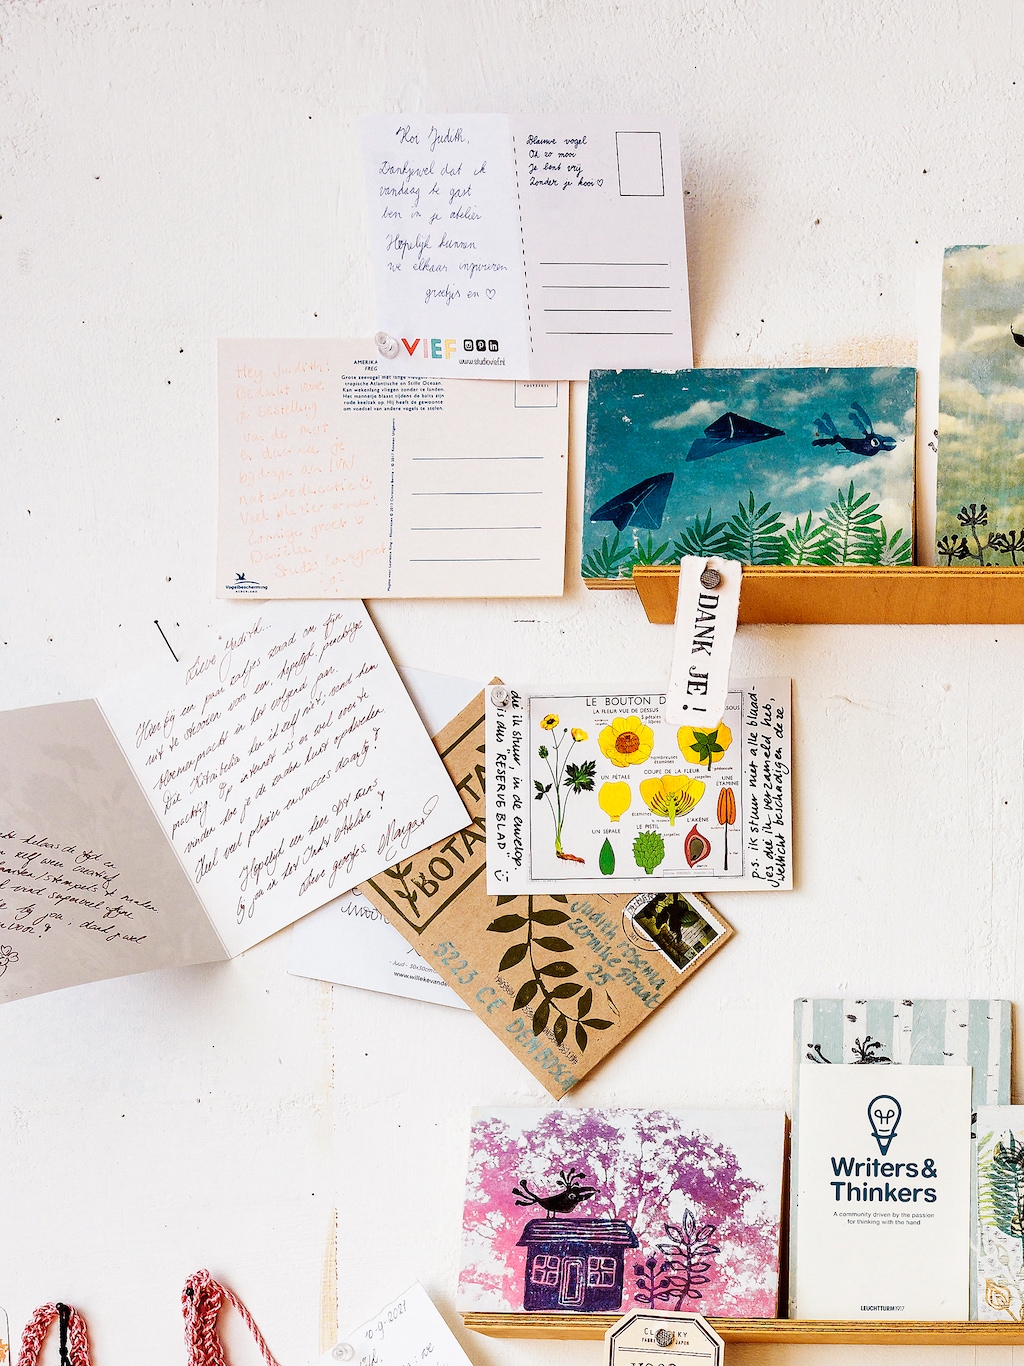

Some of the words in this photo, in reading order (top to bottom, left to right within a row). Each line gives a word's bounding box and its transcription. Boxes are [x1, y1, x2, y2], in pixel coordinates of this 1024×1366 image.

[440, 162, 463, 176] dat
[473, 160, 488, 176] ik
[466, 289, 480, 299] en
[401, 338, 457, 360] VIEF
[691, 592, 719, 656] DANK
[686, 665, 709, 696] JE
[510, 690, 522, 709] die
[586, 698, 597, 707] LE
[605, 696, 651, 706] BOUTON
[496, 720, 507, 743] dus
[748, 732, 758, 757] alle
[512, 776, 522, 791] in
[745, 761, 759, 788] niet
[512, 794, 522, 811] de
[748, 794, 760, 833] stuur
[762, 814, 773, 834] ik
[748, 838, 758, 851] ik
[762, 839, 774, 860] die
[433, 942, 479, 985] 5223
[476, 987, 507, 1014] CE
[585, 964, 616, 987] 25
[830, 1182, 937, 1203] Thinkers
